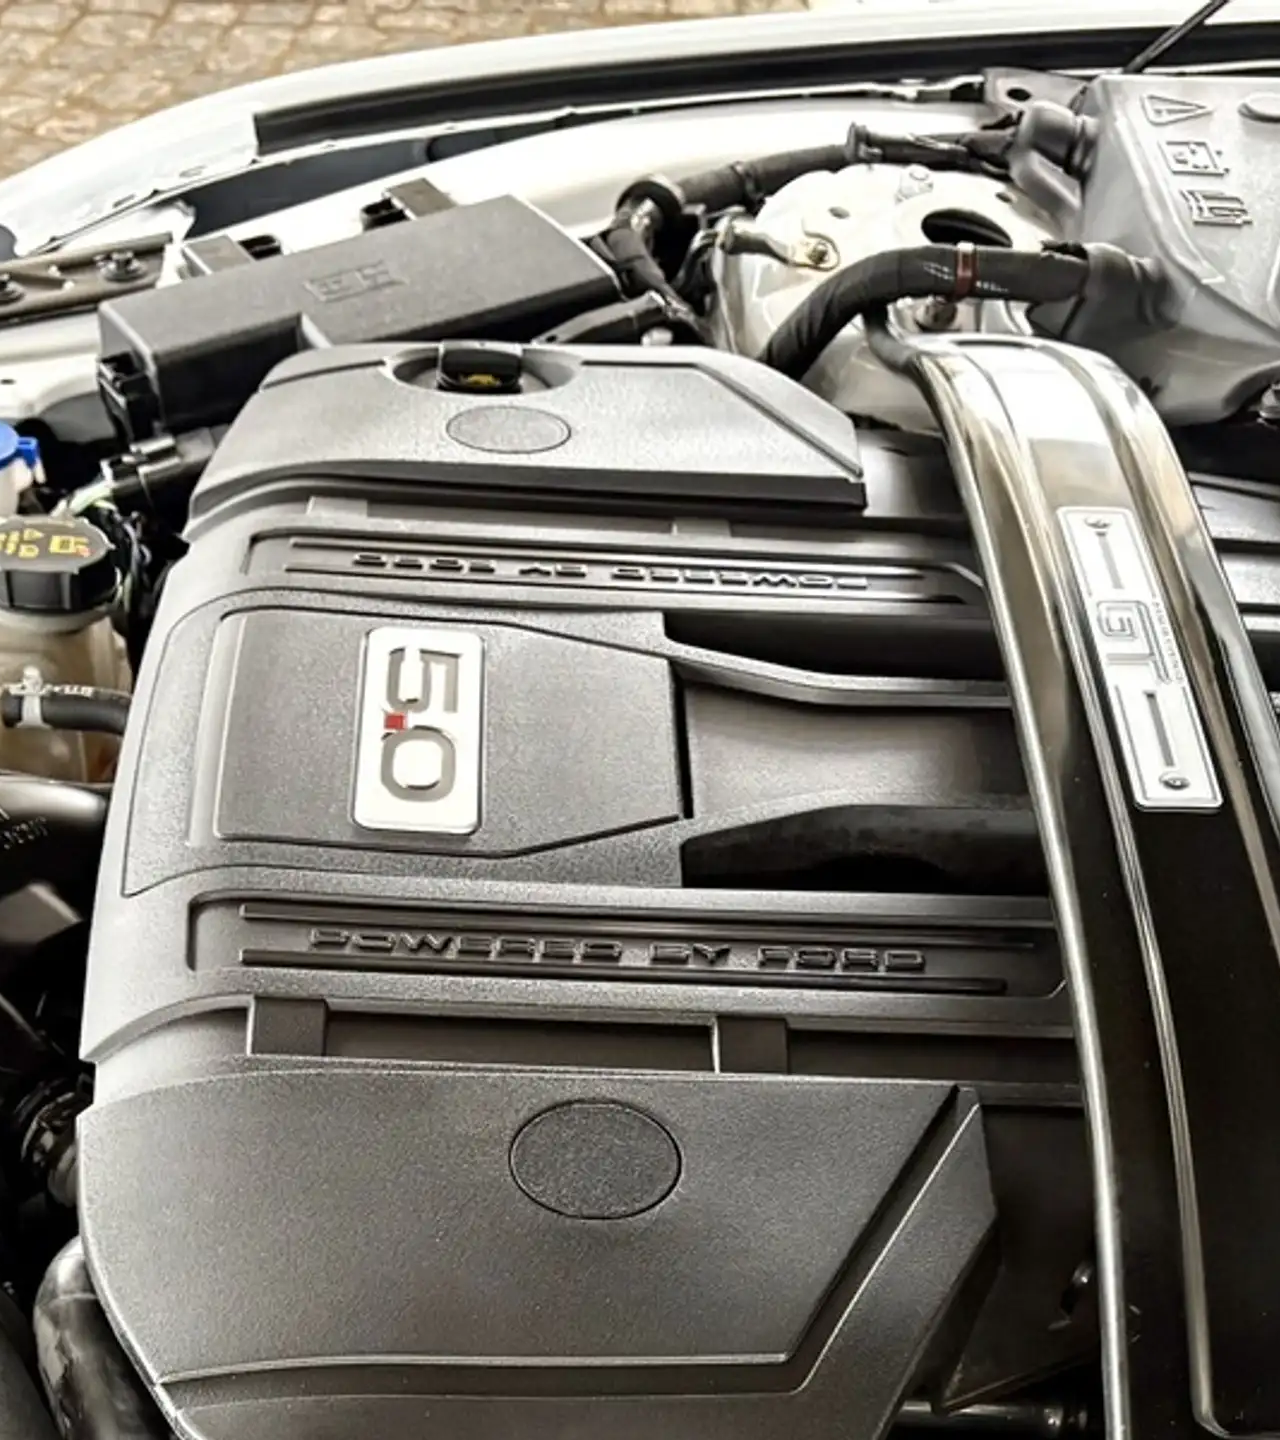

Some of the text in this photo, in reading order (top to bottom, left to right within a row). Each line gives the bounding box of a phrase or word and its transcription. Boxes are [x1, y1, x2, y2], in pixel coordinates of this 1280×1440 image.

[1096, 599, 1171, 685] GT
[380, 646, 462, 804] 5.0
[308, 927, 926, 975] POWERED BY FORD
